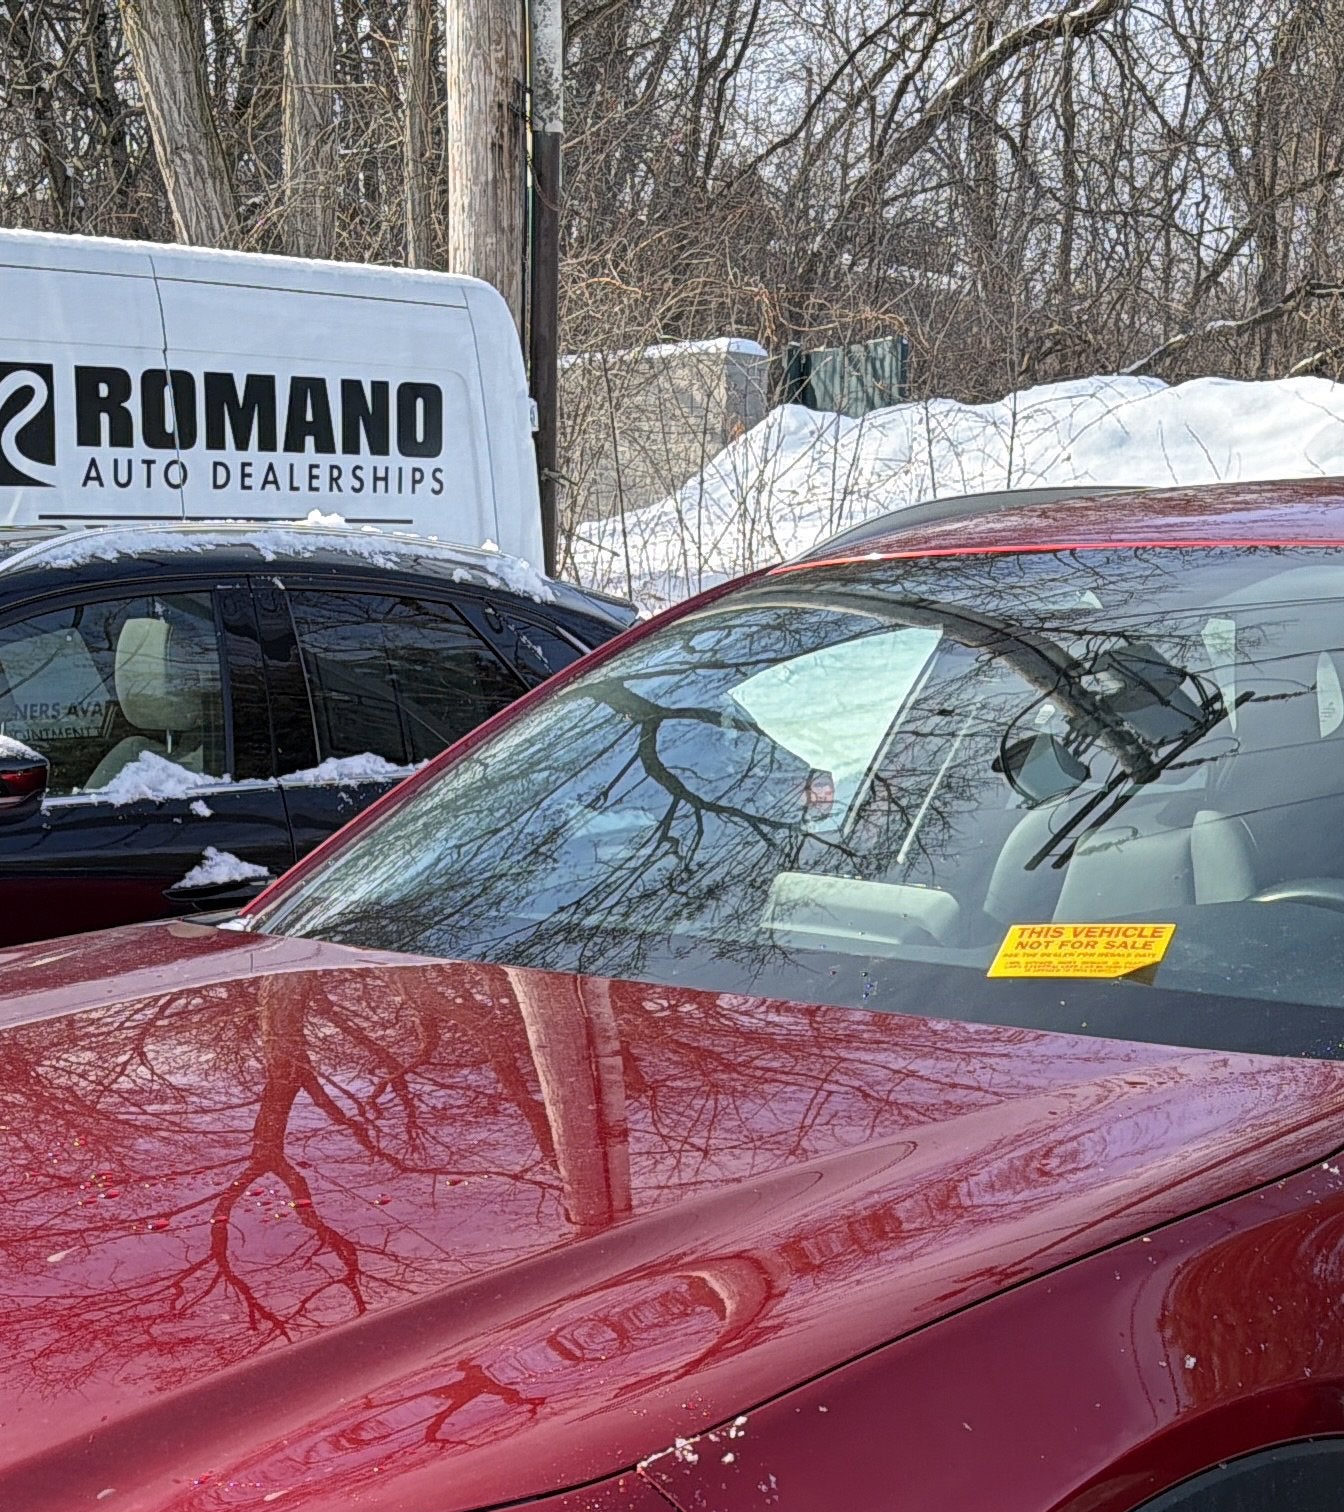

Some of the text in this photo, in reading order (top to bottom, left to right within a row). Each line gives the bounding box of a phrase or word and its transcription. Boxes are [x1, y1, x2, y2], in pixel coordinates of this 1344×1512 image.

[74, 365, 443, 458] ROMANO
[82, 457, 444, 495] AUTO DEALERSHIPS
[1015, 940, 1155, 950] NOT FOR SALE
[1018, 927, 1166, 939] THIS VEHICLE
